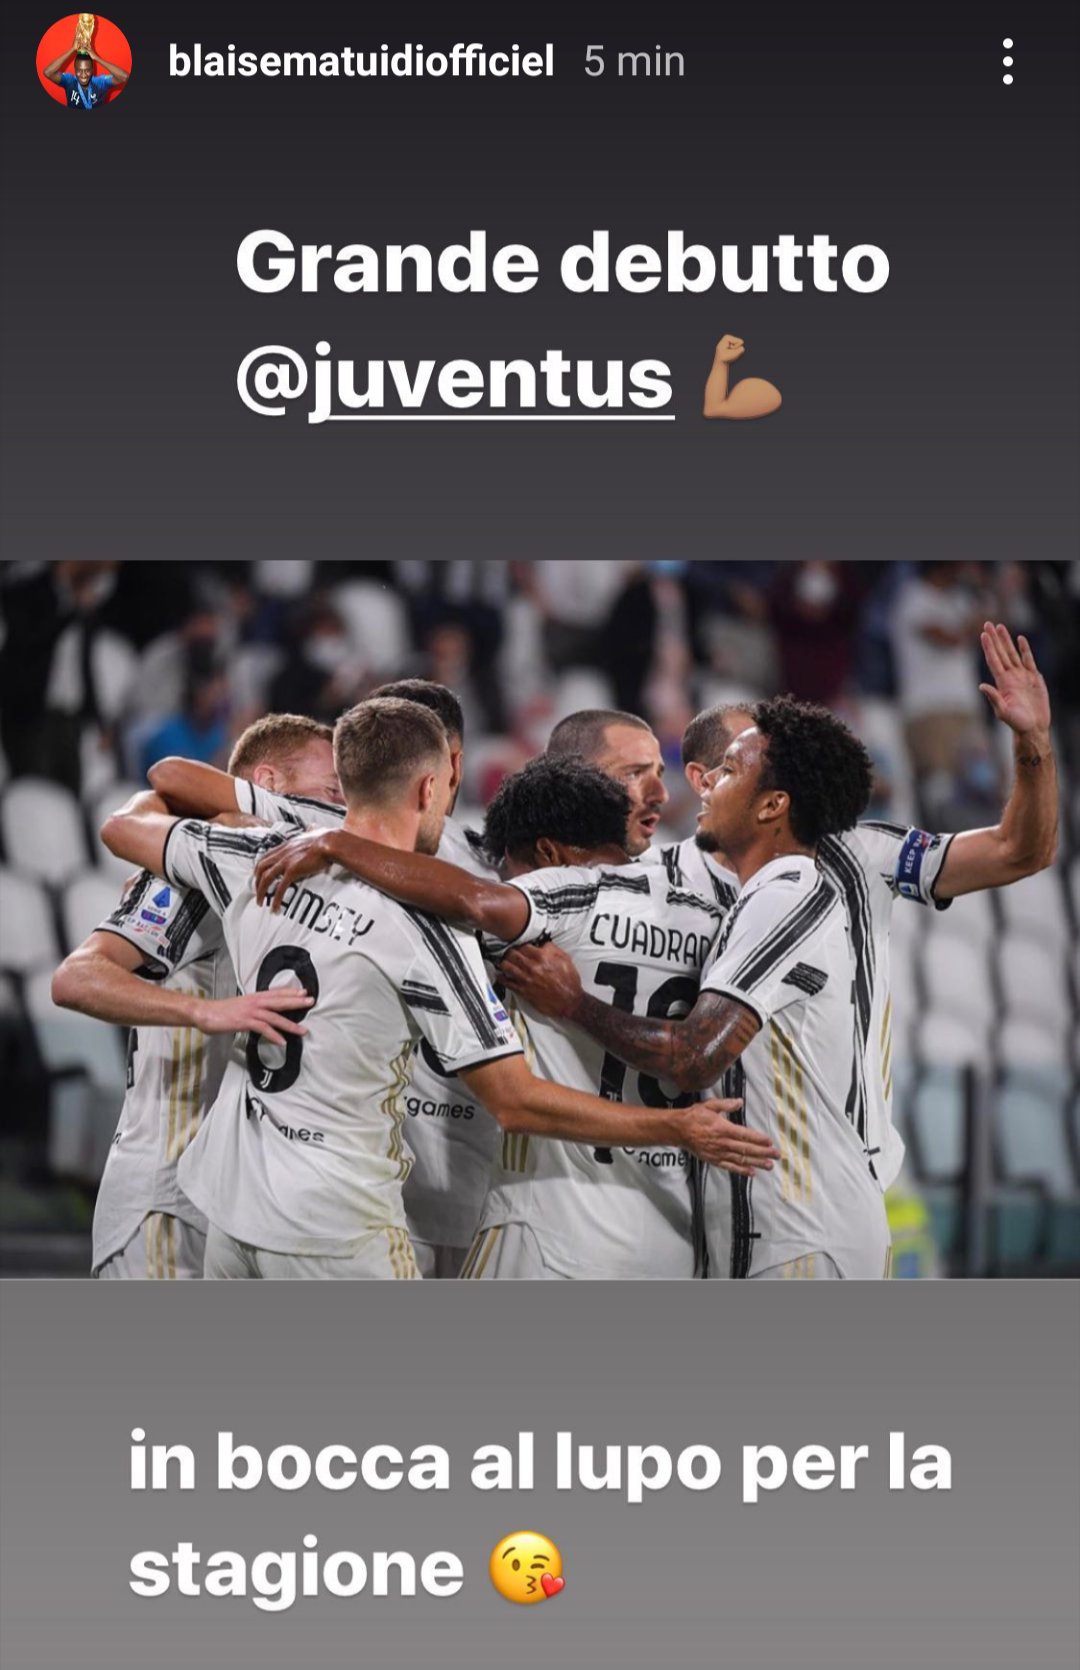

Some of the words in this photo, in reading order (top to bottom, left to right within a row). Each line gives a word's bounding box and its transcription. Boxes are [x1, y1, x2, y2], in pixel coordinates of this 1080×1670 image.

[265, 882, 375, 947] AMSEY
[245, 944, 320, 1094] 8
[404, 1096, 476, 1121] games
